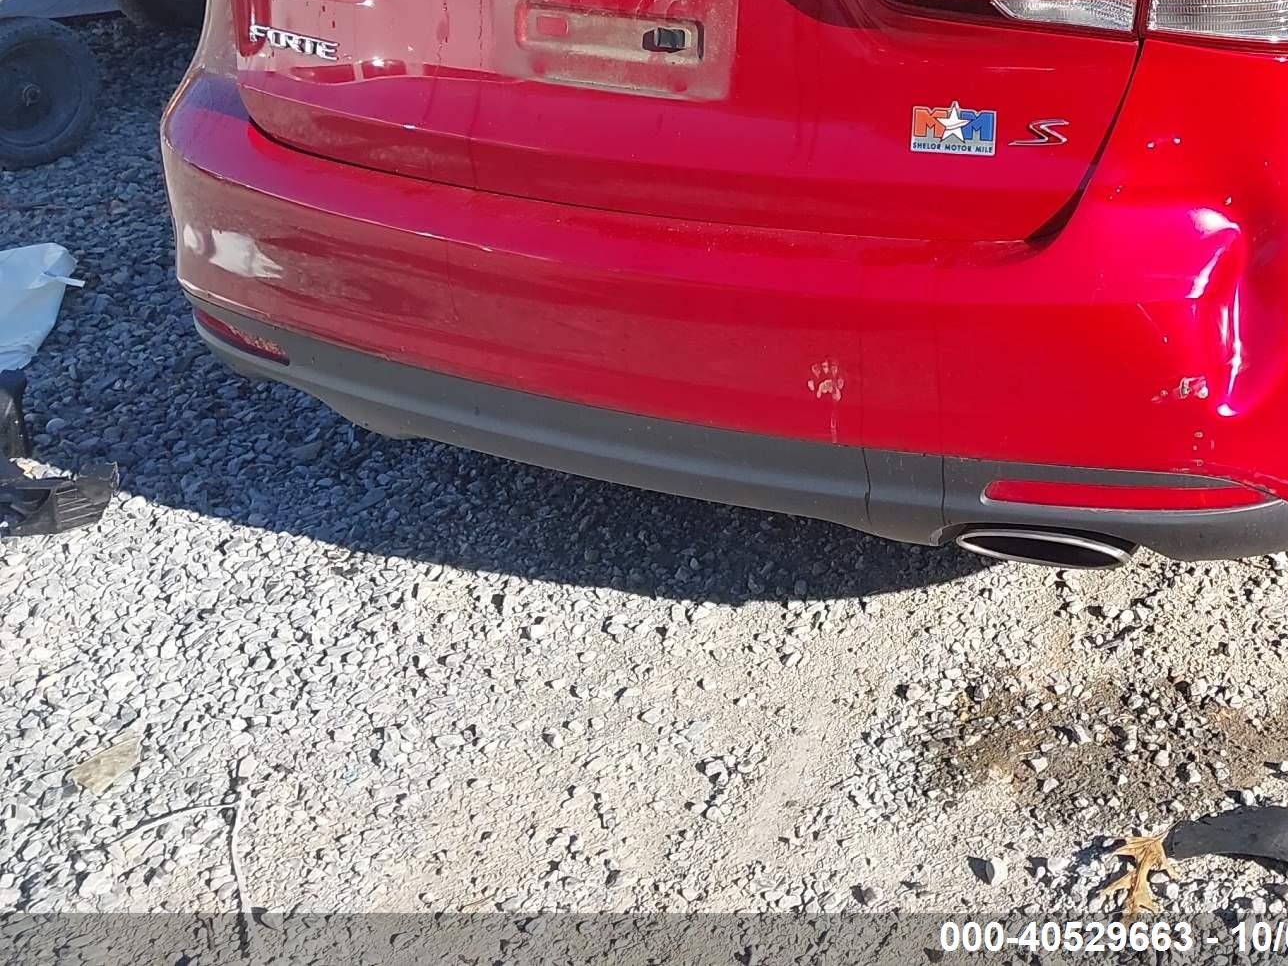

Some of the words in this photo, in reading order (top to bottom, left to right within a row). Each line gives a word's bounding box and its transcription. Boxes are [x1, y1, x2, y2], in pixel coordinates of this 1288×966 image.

[249, 25, 340, 61] FORTE
[912, 141, 941, 150] SHELOR
[944, 144, 972, 152] MOTOR
